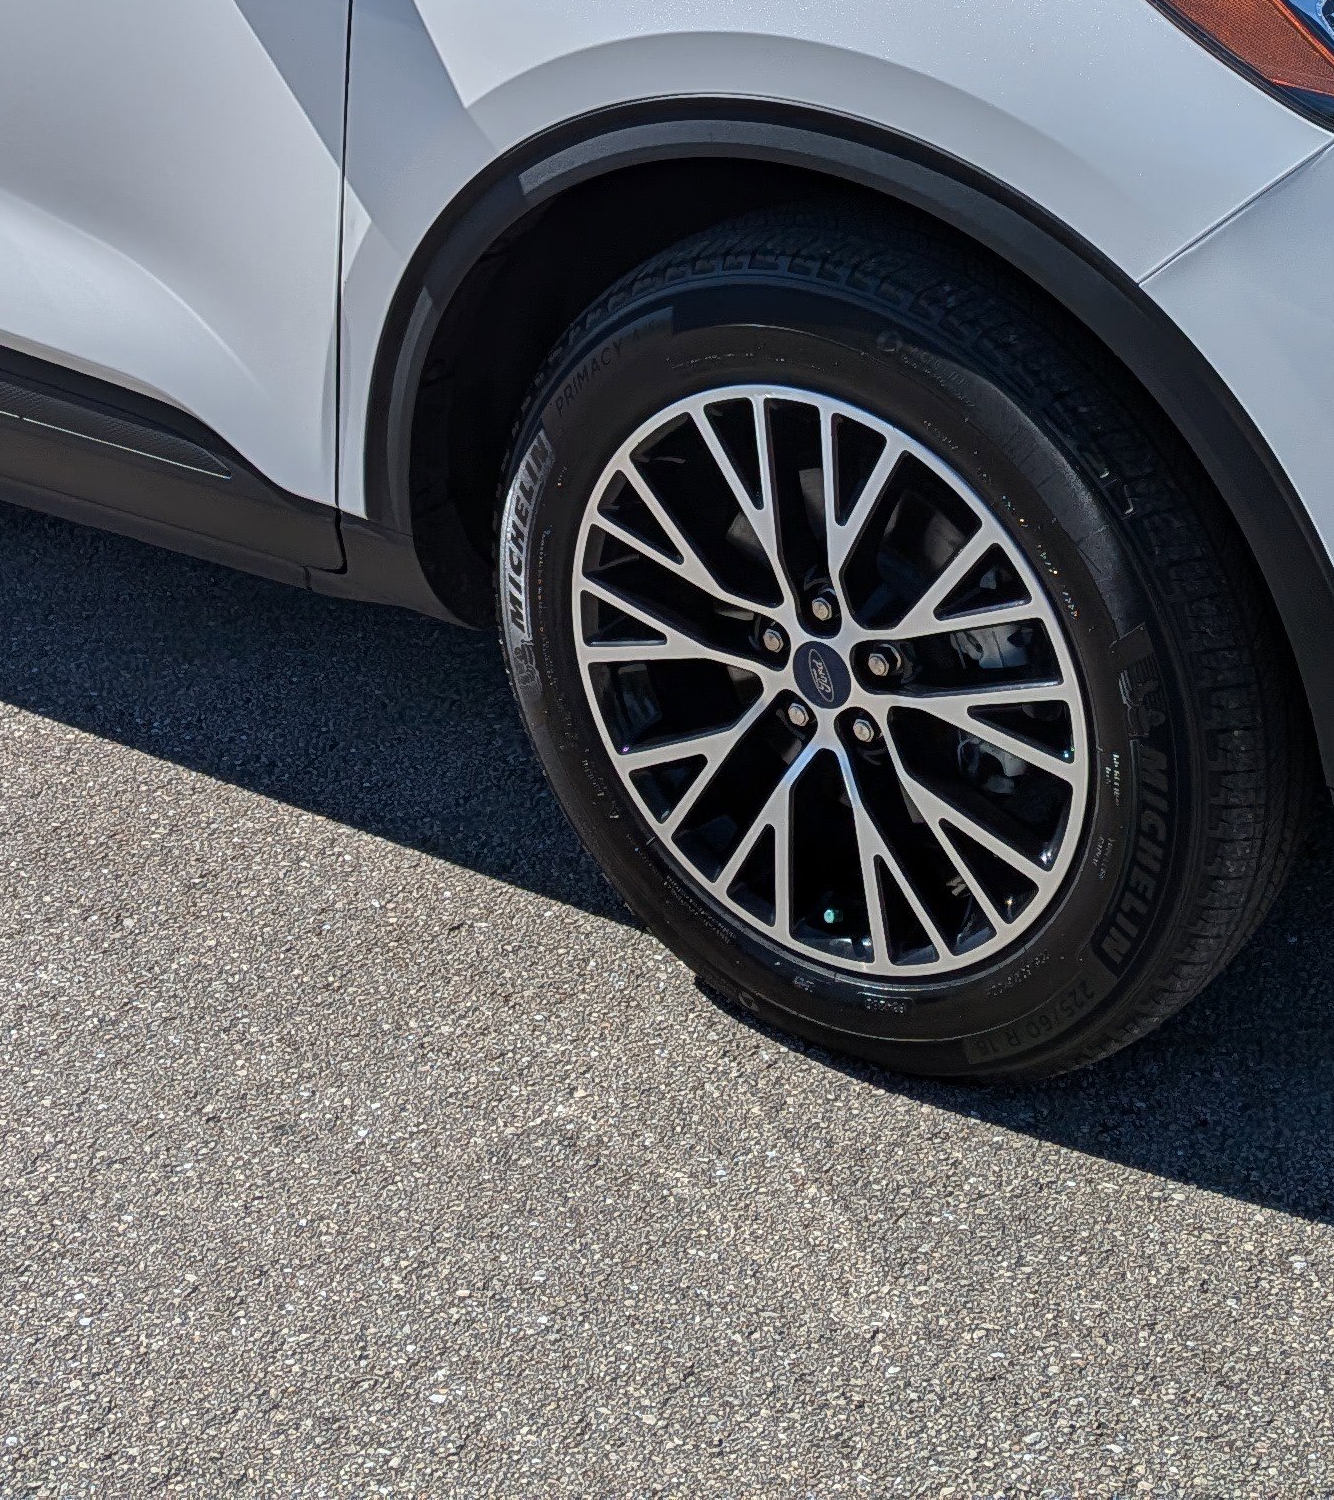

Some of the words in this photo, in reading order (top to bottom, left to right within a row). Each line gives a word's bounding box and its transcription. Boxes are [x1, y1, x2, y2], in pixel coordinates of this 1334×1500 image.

[555, 338, 623, 416] PRIMACY
[509, 434, 549, 634] MICHELIN
[811, 659, 832, 694] Ford
[1101, 749, 1169, 964] MICHELIN
